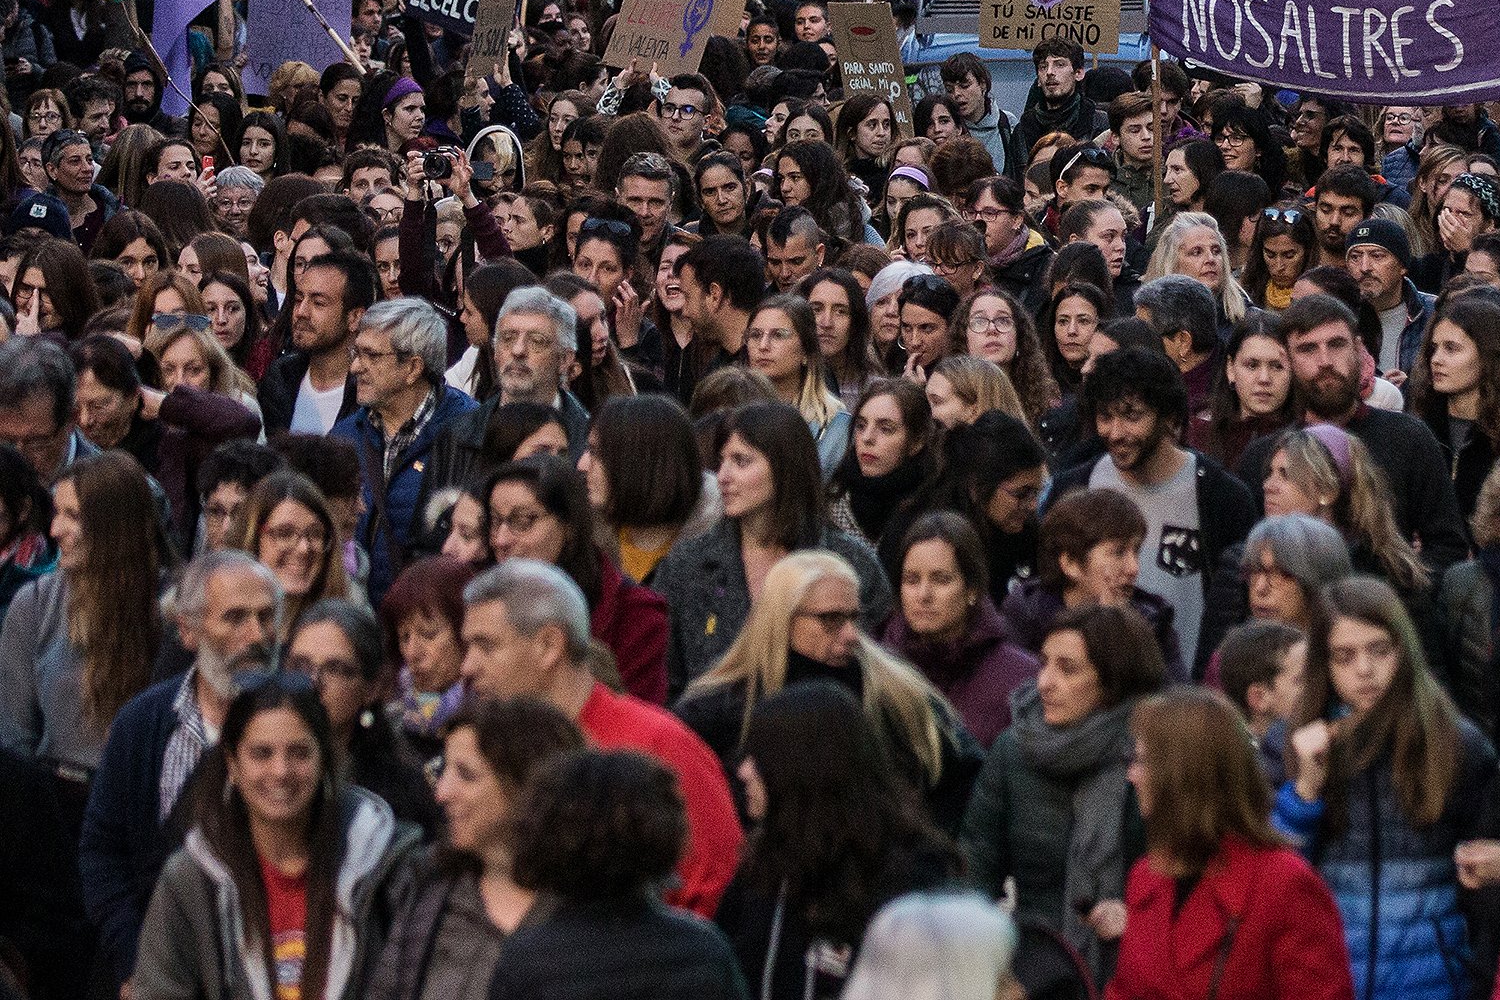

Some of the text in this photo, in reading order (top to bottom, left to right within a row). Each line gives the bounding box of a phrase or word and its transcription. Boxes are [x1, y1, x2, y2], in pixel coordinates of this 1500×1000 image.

[991, 0, 1096, 22] TÚ SALISTE
[992, 26, 1010, 40] DE
[1041, 20, 1102, 46] COÑO
[843, 61, 896, 76] PARA SANTO
[895, 111, 909, 124] AL
